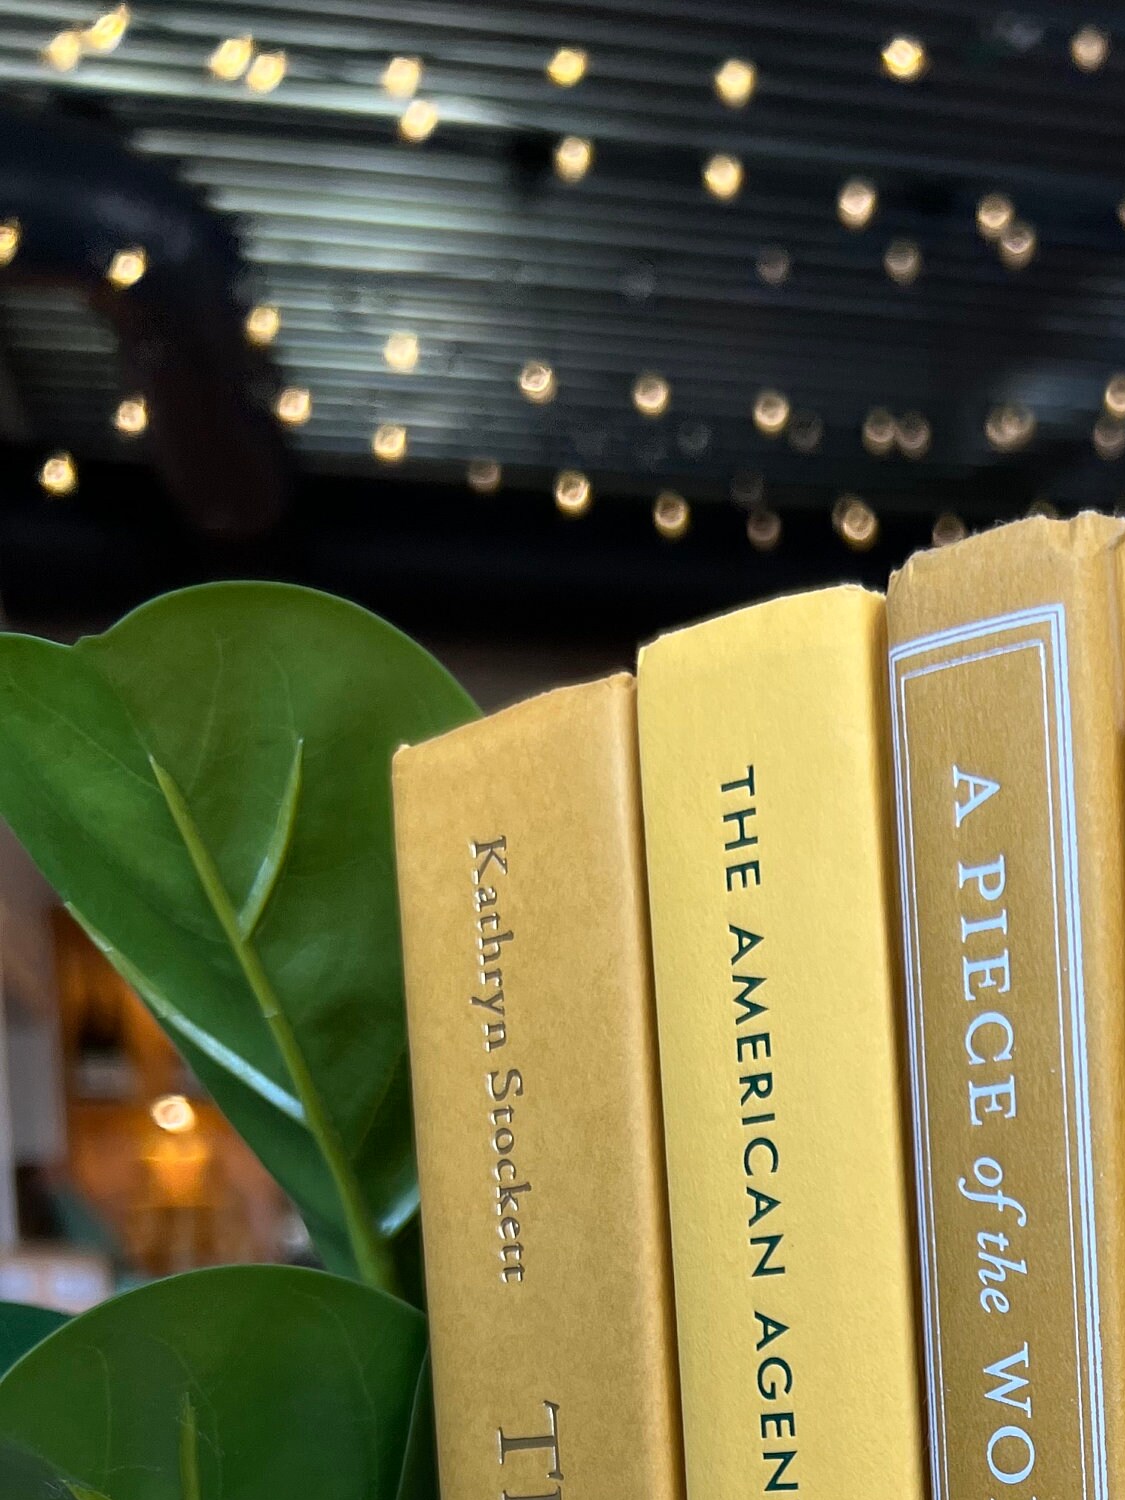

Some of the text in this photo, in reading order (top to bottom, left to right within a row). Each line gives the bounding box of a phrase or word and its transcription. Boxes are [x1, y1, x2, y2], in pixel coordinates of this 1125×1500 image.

[720, 764, 761, 892] THE
[952, 764, 1001, 828] A
[958, 853, 1018, 1127] PIECE
[469, 834, 532, 1284] Kathryn Stockett
[728, 923, 786, 1277] AMERICAN
[957, 1156, 1028, 1229] of
[976, 1230, 1029, 1315] the
